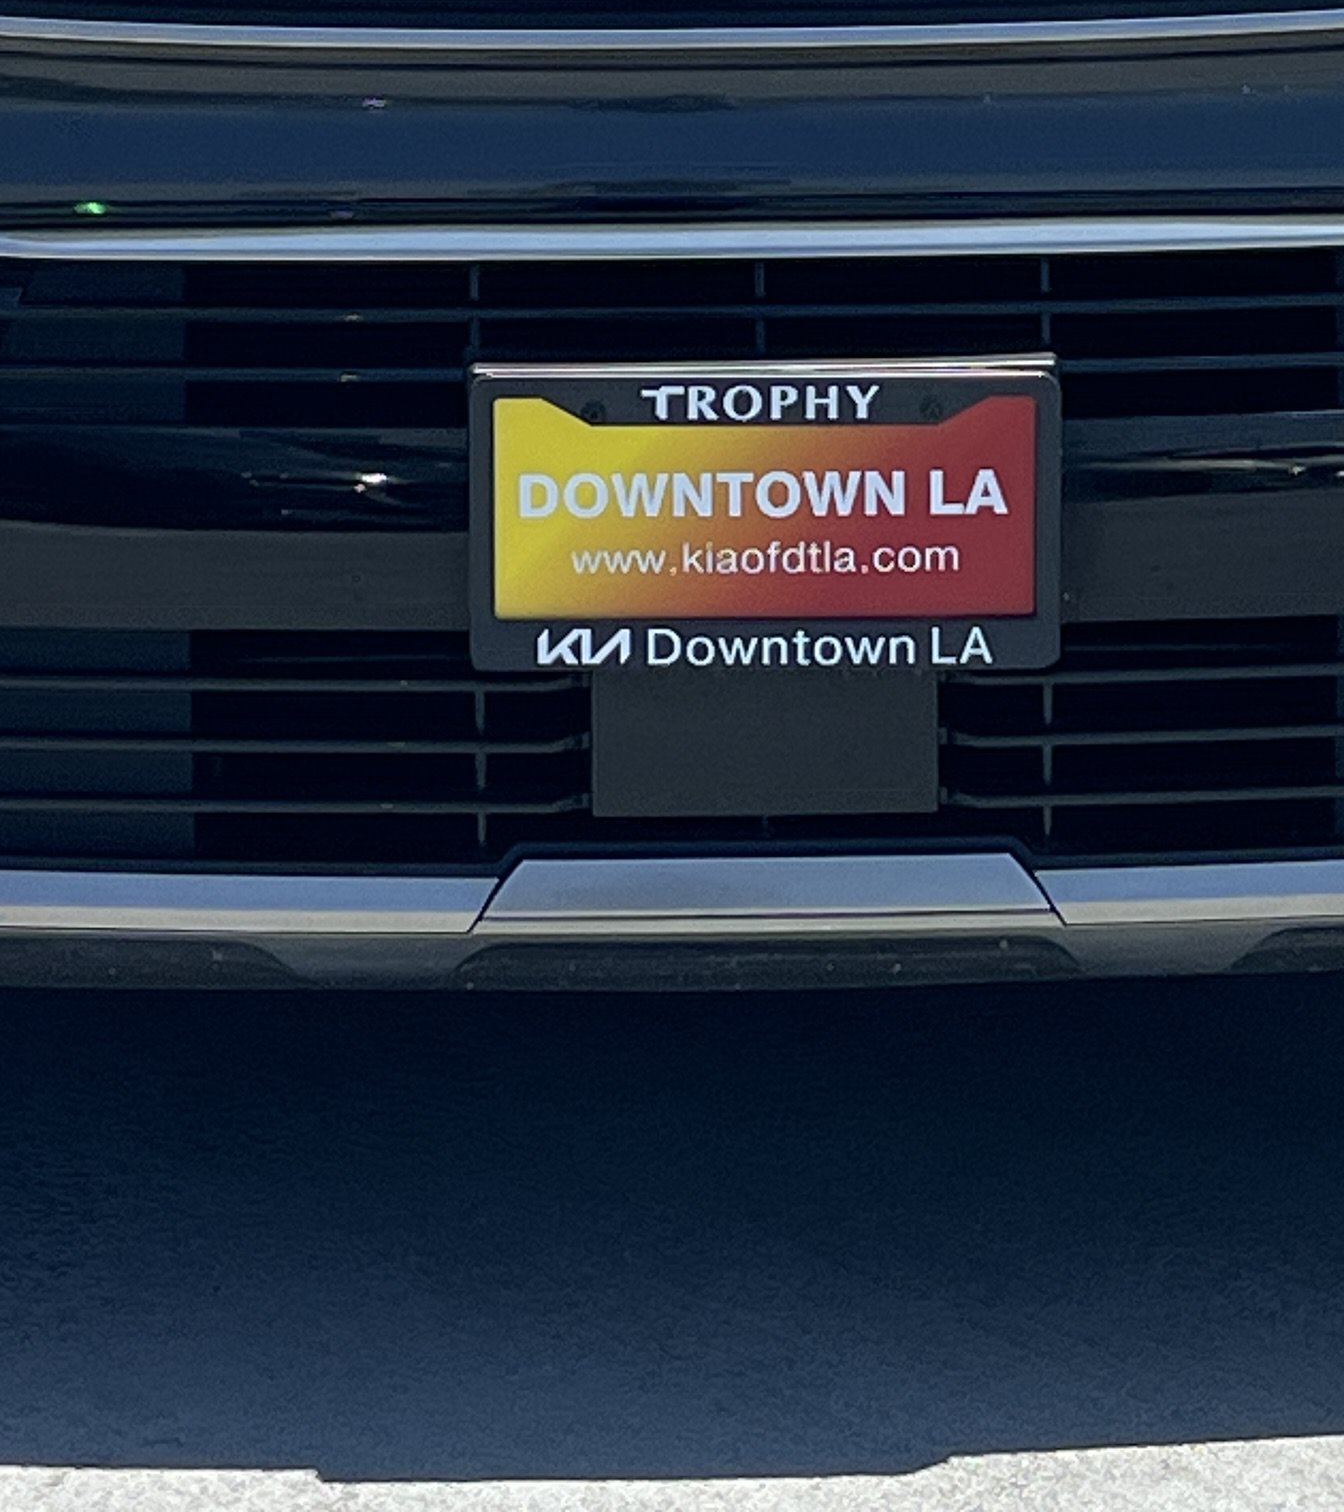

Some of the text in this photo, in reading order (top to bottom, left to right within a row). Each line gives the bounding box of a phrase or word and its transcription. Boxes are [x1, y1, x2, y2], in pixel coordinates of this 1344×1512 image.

[641, 384, 880, 421] TROPHY
[518, 468, 1009, 518] DOWNTOWN LA
[572, 540, 960, 575] www.kiaofdtla.com
[536, 626, 993, 666] KIA Downtown LA
